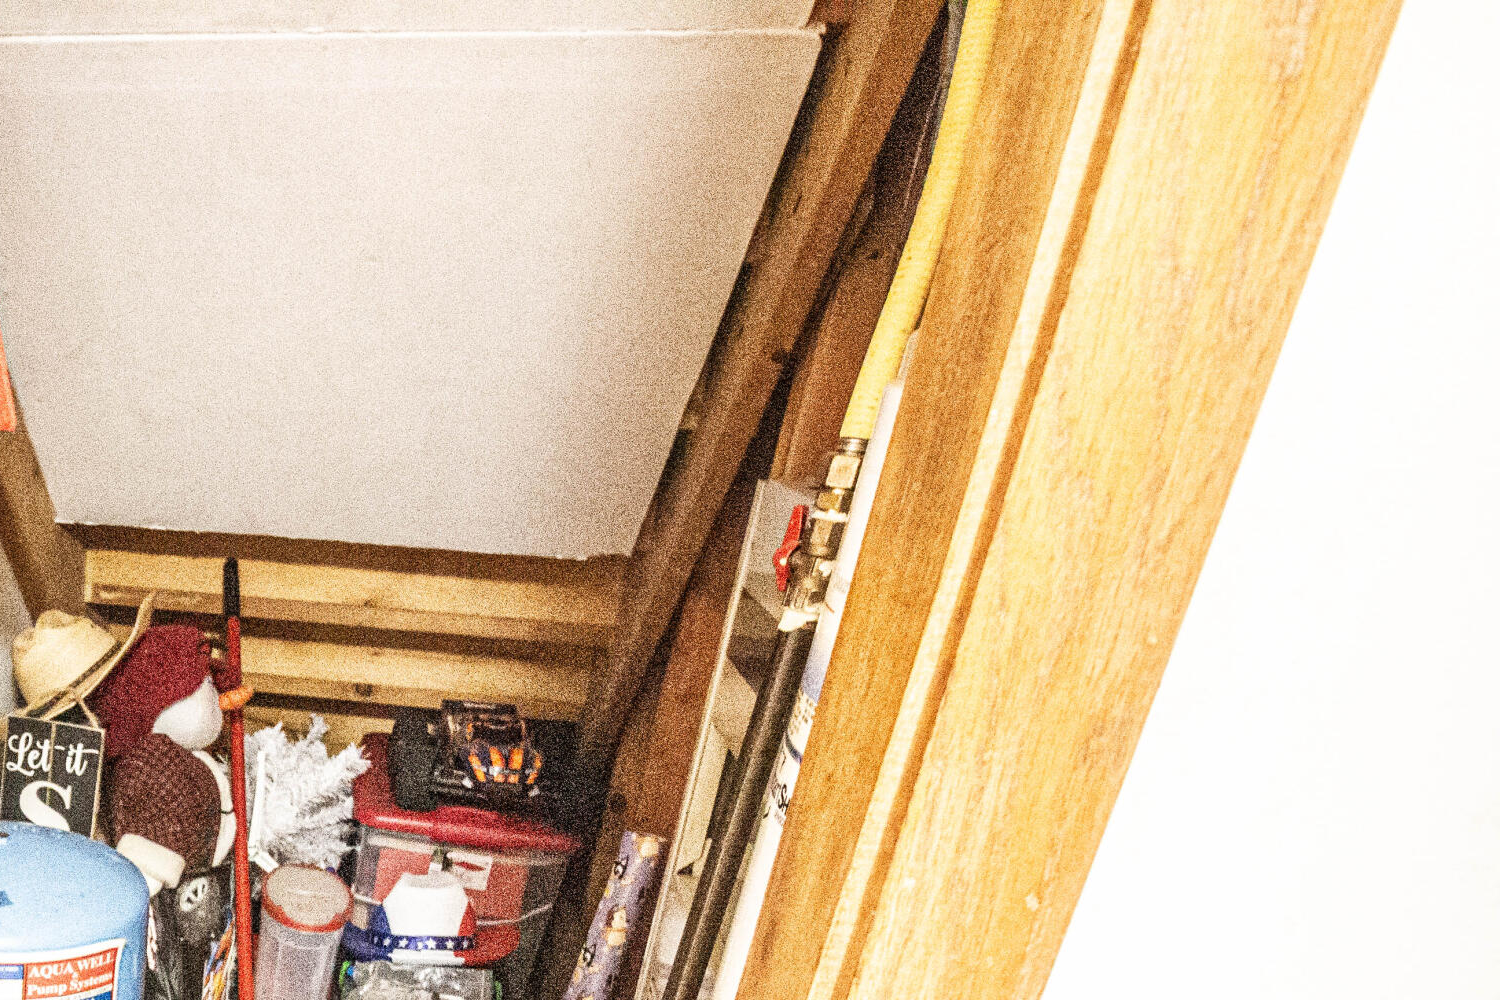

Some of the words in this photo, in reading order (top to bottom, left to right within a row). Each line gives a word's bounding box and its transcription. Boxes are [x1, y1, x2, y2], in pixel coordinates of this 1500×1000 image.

[6, 732, 64, 777] Let
[65, 741, 100, 777] it
[28, 961, 74, 979] AQUA
[76, 951, 115, 971] WELL
[27, 983, 68, 996] Pump
[69, 971, 113, 991] Systems
